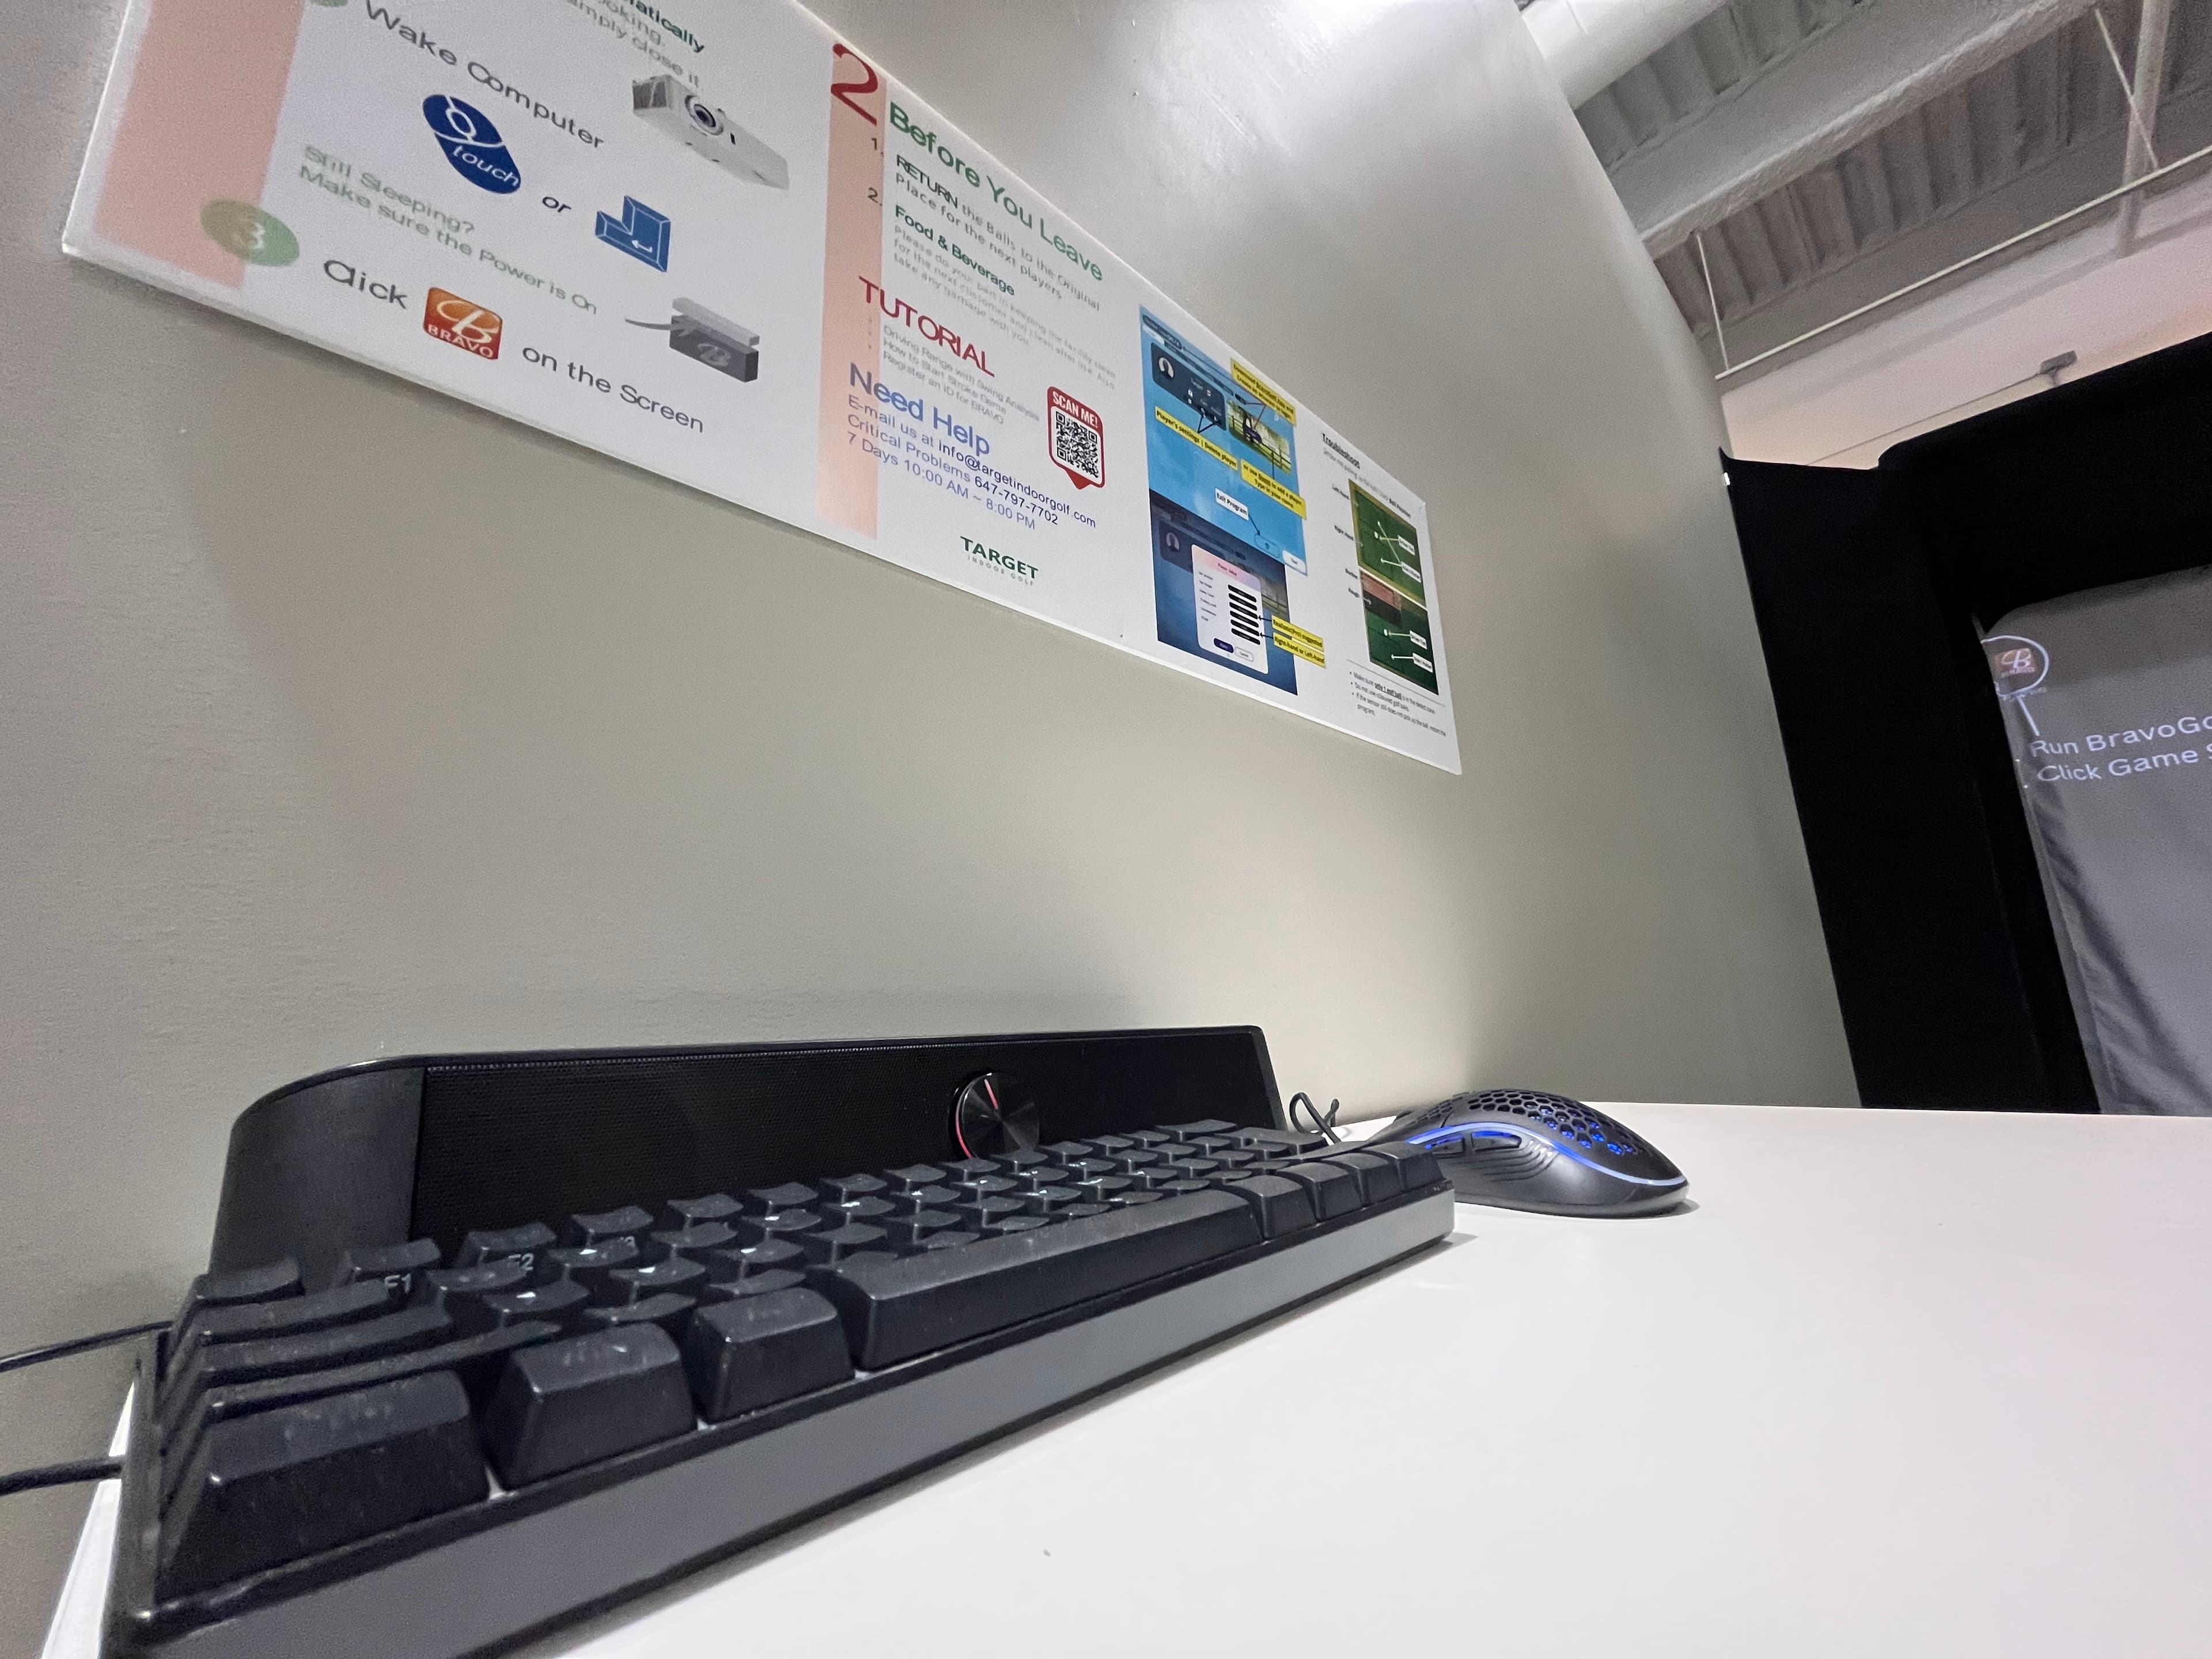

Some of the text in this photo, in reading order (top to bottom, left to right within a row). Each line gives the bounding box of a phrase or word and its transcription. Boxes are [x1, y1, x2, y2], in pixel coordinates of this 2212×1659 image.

[630, 0, 704, 53] atically
[367, 0, 604, 147] Wake Computer
[830, 43, 878, 127] 2
[304, 146, 475, 234] Still Sleeping?
[453, 145, 519, 187] touch
[541, 196, 571, 213] or
[890, 101, 1103, 281] Before You Leave
[300, 165, 597, 315] Make sure the Power is On
[895, 204, 933, 241] Food
[937, 233, 948, 252] &
[952, 243, 1015, 296] Beverage
[896, 154, 958, 209] RETURN
[962, 202, 984, 228] the
[987, 221, 1016, 251] Balls
[1021, 245, 1032, 264] to
[1058, 274, 1100, 312] Original
[896, 172, 1062, 300] Place for the next players
[324, 260, 407, 309] Click
[859, 275, 995, 378] TUTORIAL
[427, 324, 494, 358] BRAVO
[522, 347, 703, 433] on the Screen
[850, 362, 990, 457] Need Help
[971, 400, 1004, 425] BRAVO
[1052, 389, 1097, 429] SCAN ME!
[847, 414, 1058, 525] Critical Problems 647-797-7702
[847, 431, 855, 446] 7
[862, 438, 899, 465] Days
[904, 459, 943, 486] 10:00
[946, 480, 968, 499] AM
[986, 498, 1013, 519] 8:00
[1016, 512, 1035, 530] PM
[848, 393, 1096, 528] E-mail us at info@targetindoorgolf.com
[1217, 491, 1247, 517] Exit Program
[960, 536, 1039, 579] TARGET
[2031, 740, 2079, 757] Run
[2086, 715, 2212, 752] BravoGo
[2037, 764, 2101, 782] Click
[2108, 750, 2199, 777] Game
